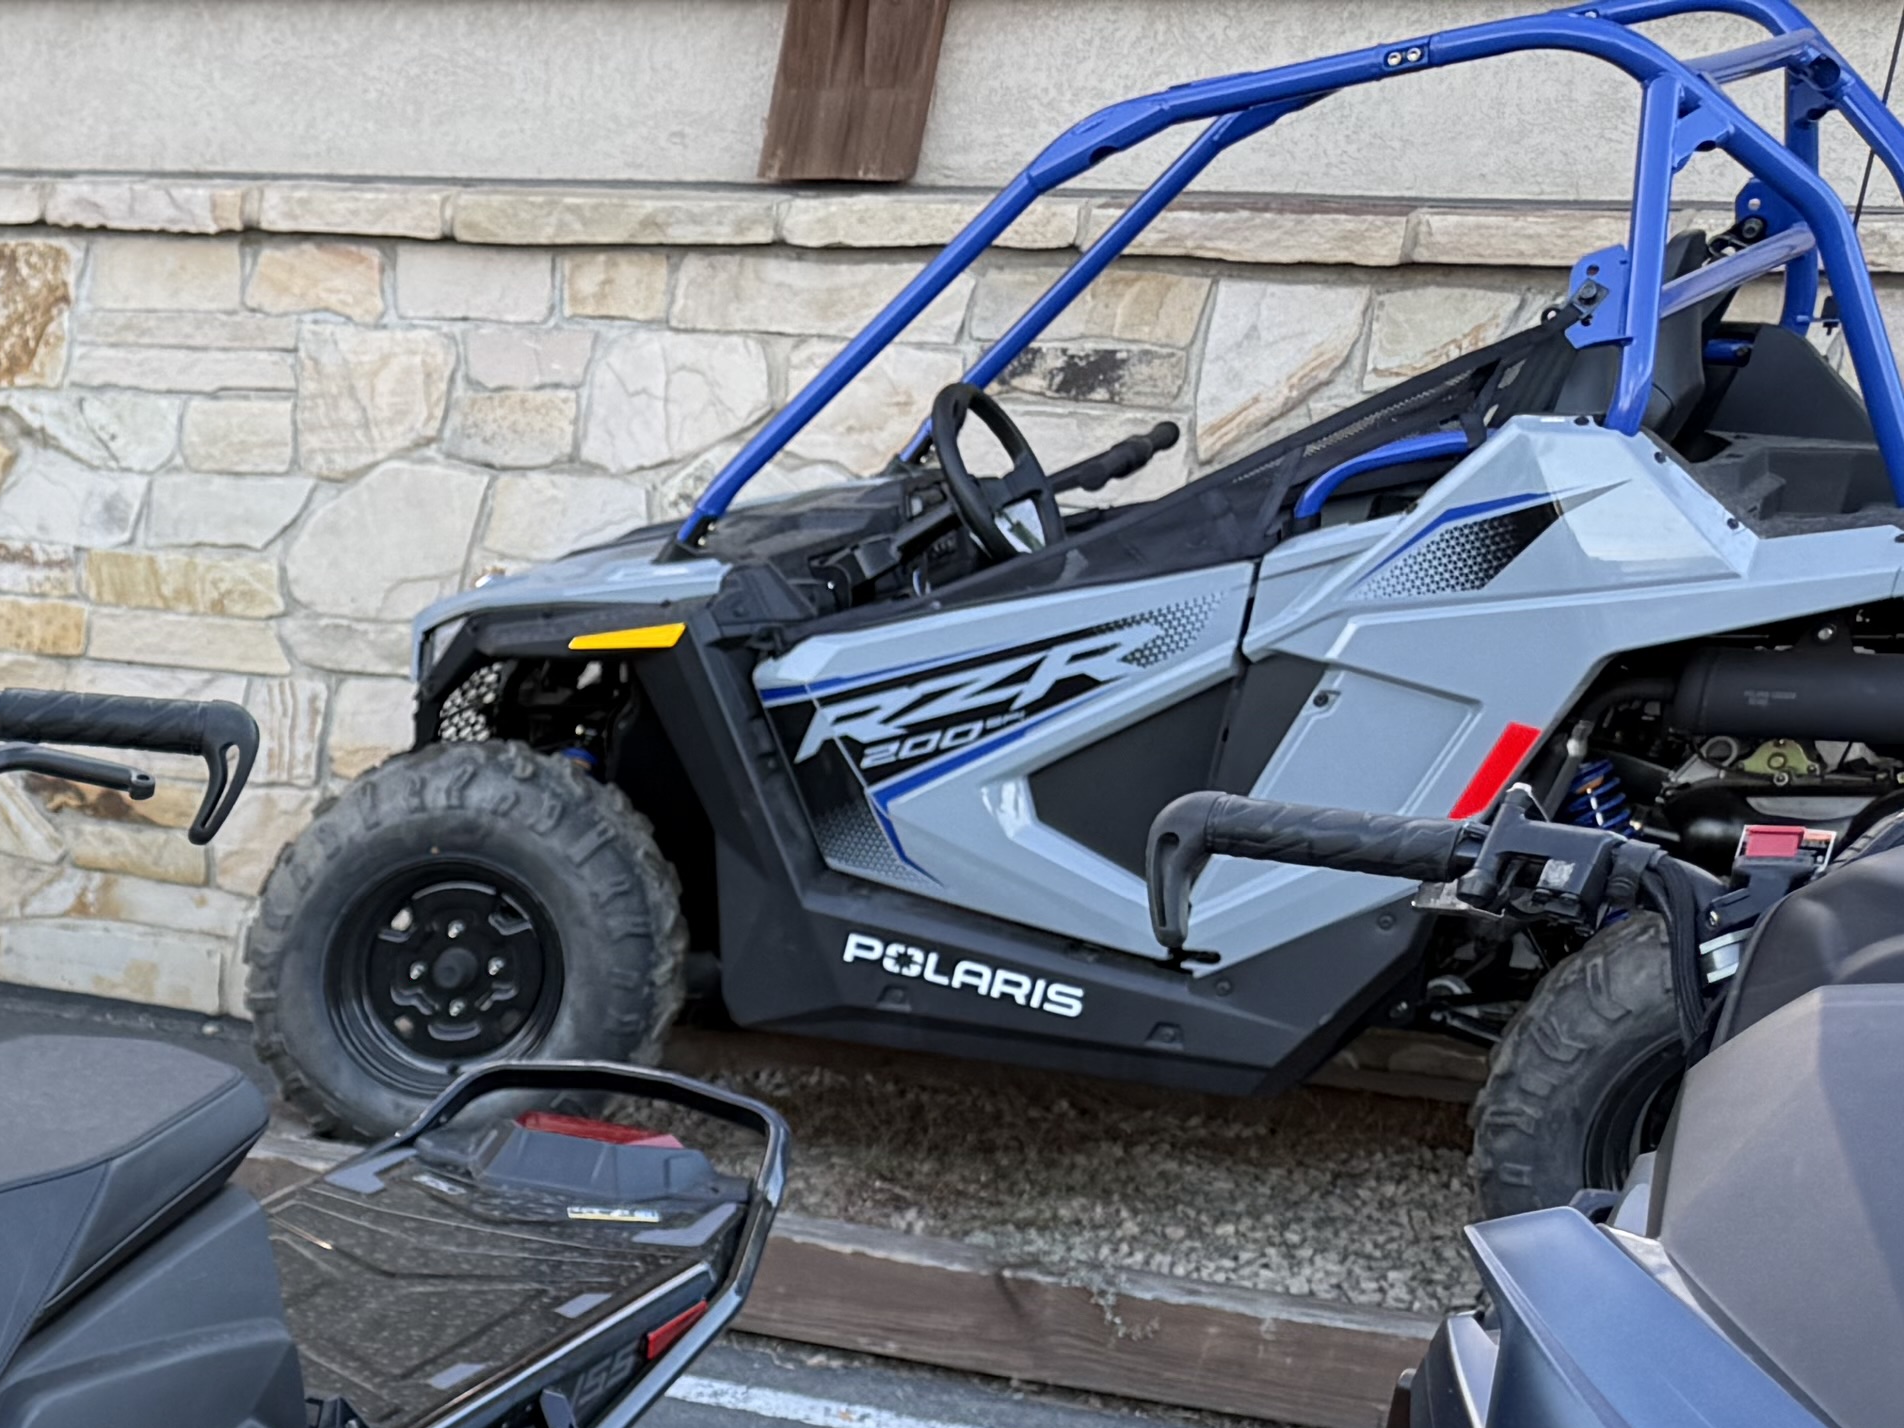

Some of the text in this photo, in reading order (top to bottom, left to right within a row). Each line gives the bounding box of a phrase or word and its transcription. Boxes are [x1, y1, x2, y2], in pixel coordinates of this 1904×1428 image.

[793, 622, 1167, 764] RZR
[860, 721, 985, 770] 200
[843, 932, 1085, 1018] POLARIS
